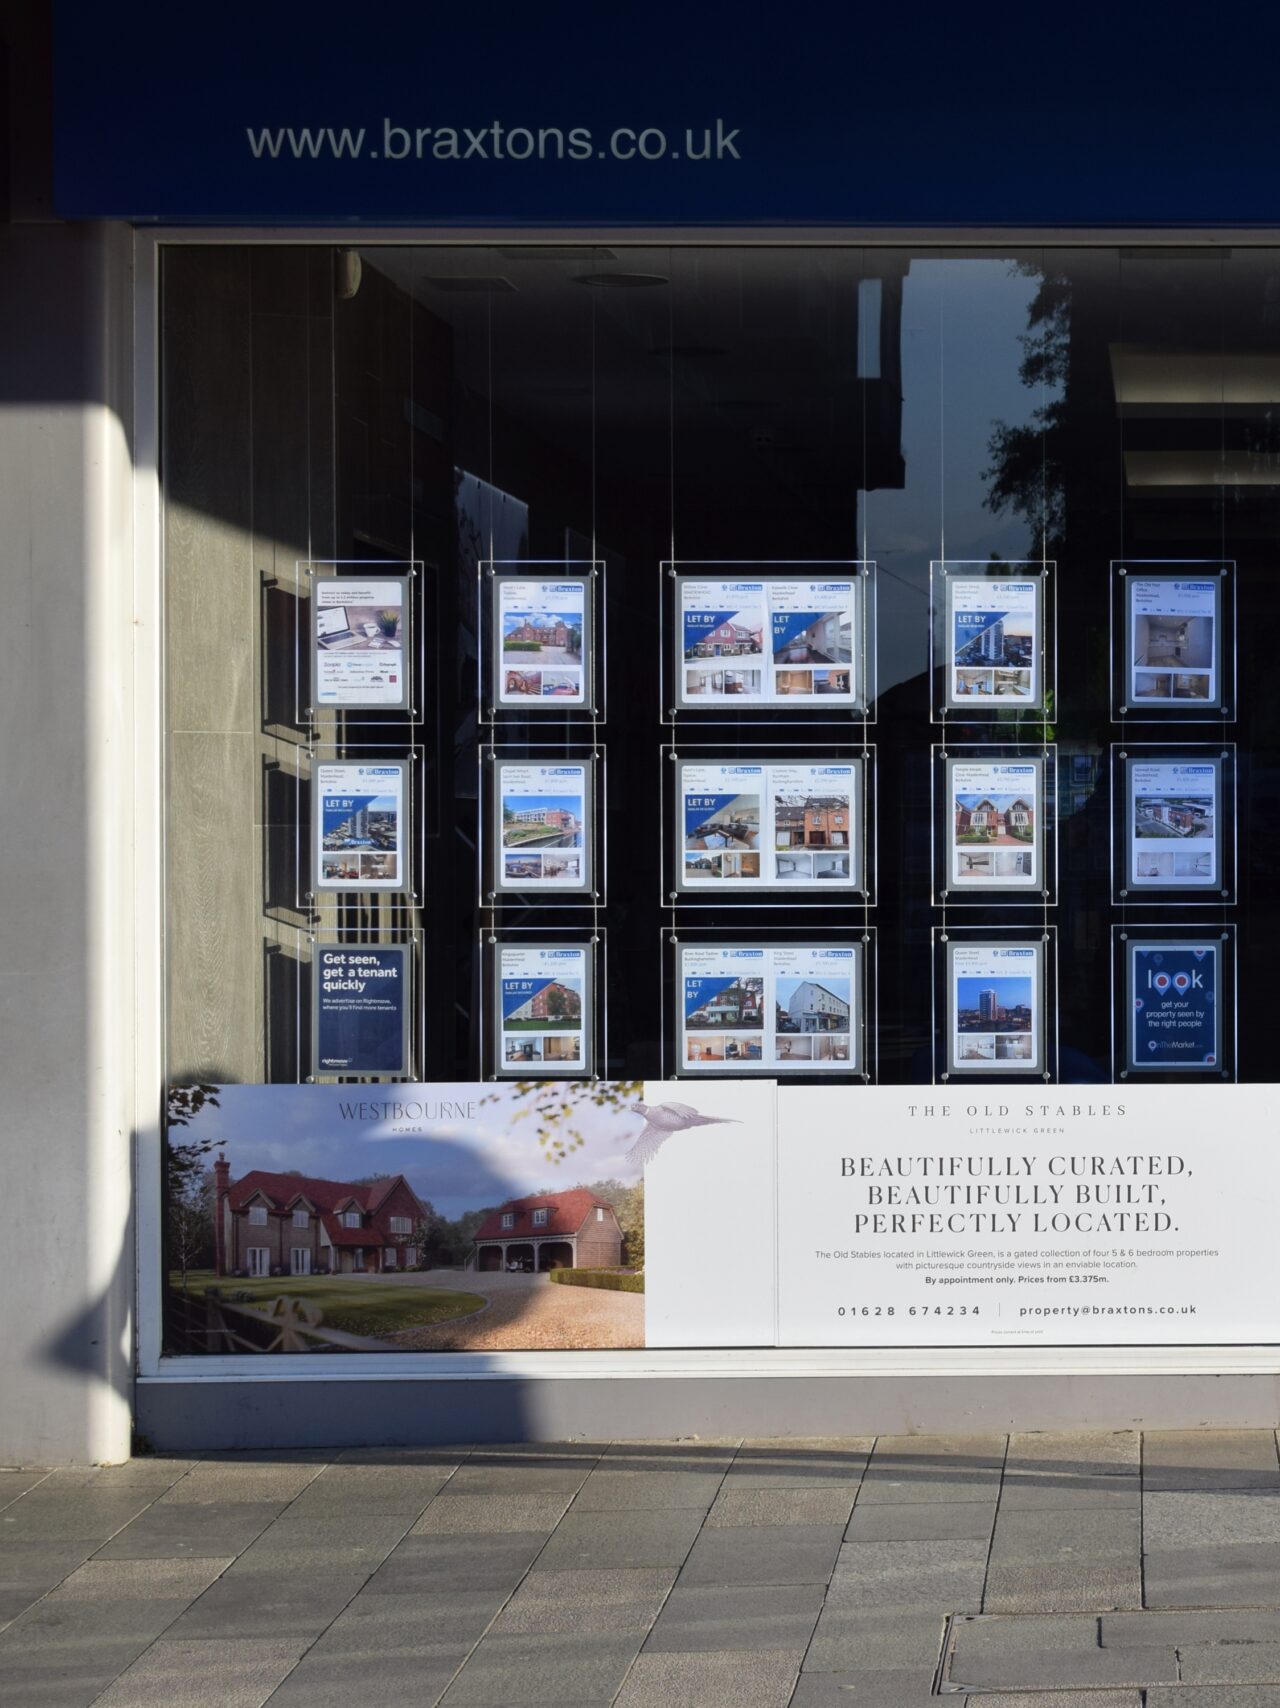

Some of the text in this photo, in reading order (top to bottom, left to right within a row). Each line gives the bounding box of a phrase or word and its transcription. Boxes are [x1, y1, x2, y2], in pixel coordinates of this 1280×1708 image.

[246, 118, 742, 160] www.braxtons.co.uk
[687, 615, 715, 623] LET BY
[774, 616, 789, 624] LET
[958, 615, 986, 623] LET BY
[774, 626, 786, 635] BY
[326, 799, 354, 808] LET BY
[687, 798, 716, 807] LET BY
[323, 953, 381, 968] Get seen,
[323, 967, 398, 981] get a tenant
[323, 979, 366, 993] quickly
[505, 982, 533, 990] LET BY
[687, 980, 702, 988] LET
[1148, 969, 1204, 995] look
[687, 991, 699, 999] BY
[1161, 1001, 1189, 1010] get your
[1146, 1010, 1205, 1020] property seen by
[1148, 1019, 1202, 1029] the right people
[339, 1100, 476, 1121] WESTBOURNE
[908, 1104, 1126, 1117] THE OLD STABLES
[969, 1127, 1065, 1135] LITTLEWICK GREEN
[841, 1155, 1193, 1178] BEAUTIFULLY CURATED,
[868, 1184, 1166, 1207] BEAUTIFULLY BUILT,
[855, 1212, 1179, 1234] PERFECTLY LOCATED.
[815, 1250, 832, 1259] The
[833, 1250, 849, 1259] Old
[850, 1250, 882, 1259] Stables
[883, 1250, 915, 1259] located
[916, 1250, 925, 1258] in
[926, 1249, 966, 1259] Littlewick
[967, 1249, 996, 1259] Green,
[997, 1250, 1005, 1258] is
[1013, 1249, 1039, 1260] gated
[1039, 1249, 1081, 1258] collection
[1082, 1249, 1092, 1258] of
[1092, 1249, 1110, 1258] four
[1136, 1248, 1175, 1257] bedroom
[1176, 1249, 1219, 1259] properties
[895, 1259, 1138, 1271] with picturesque countryside views in an enviable location.
[925, 1274, 1109, 1286] By appointment only. Prices from £3.375m.
[837, 1305, 980, 1317] 01628 674234
[1019, 1304, 1197, 1317] property@braxtons.co.uk
